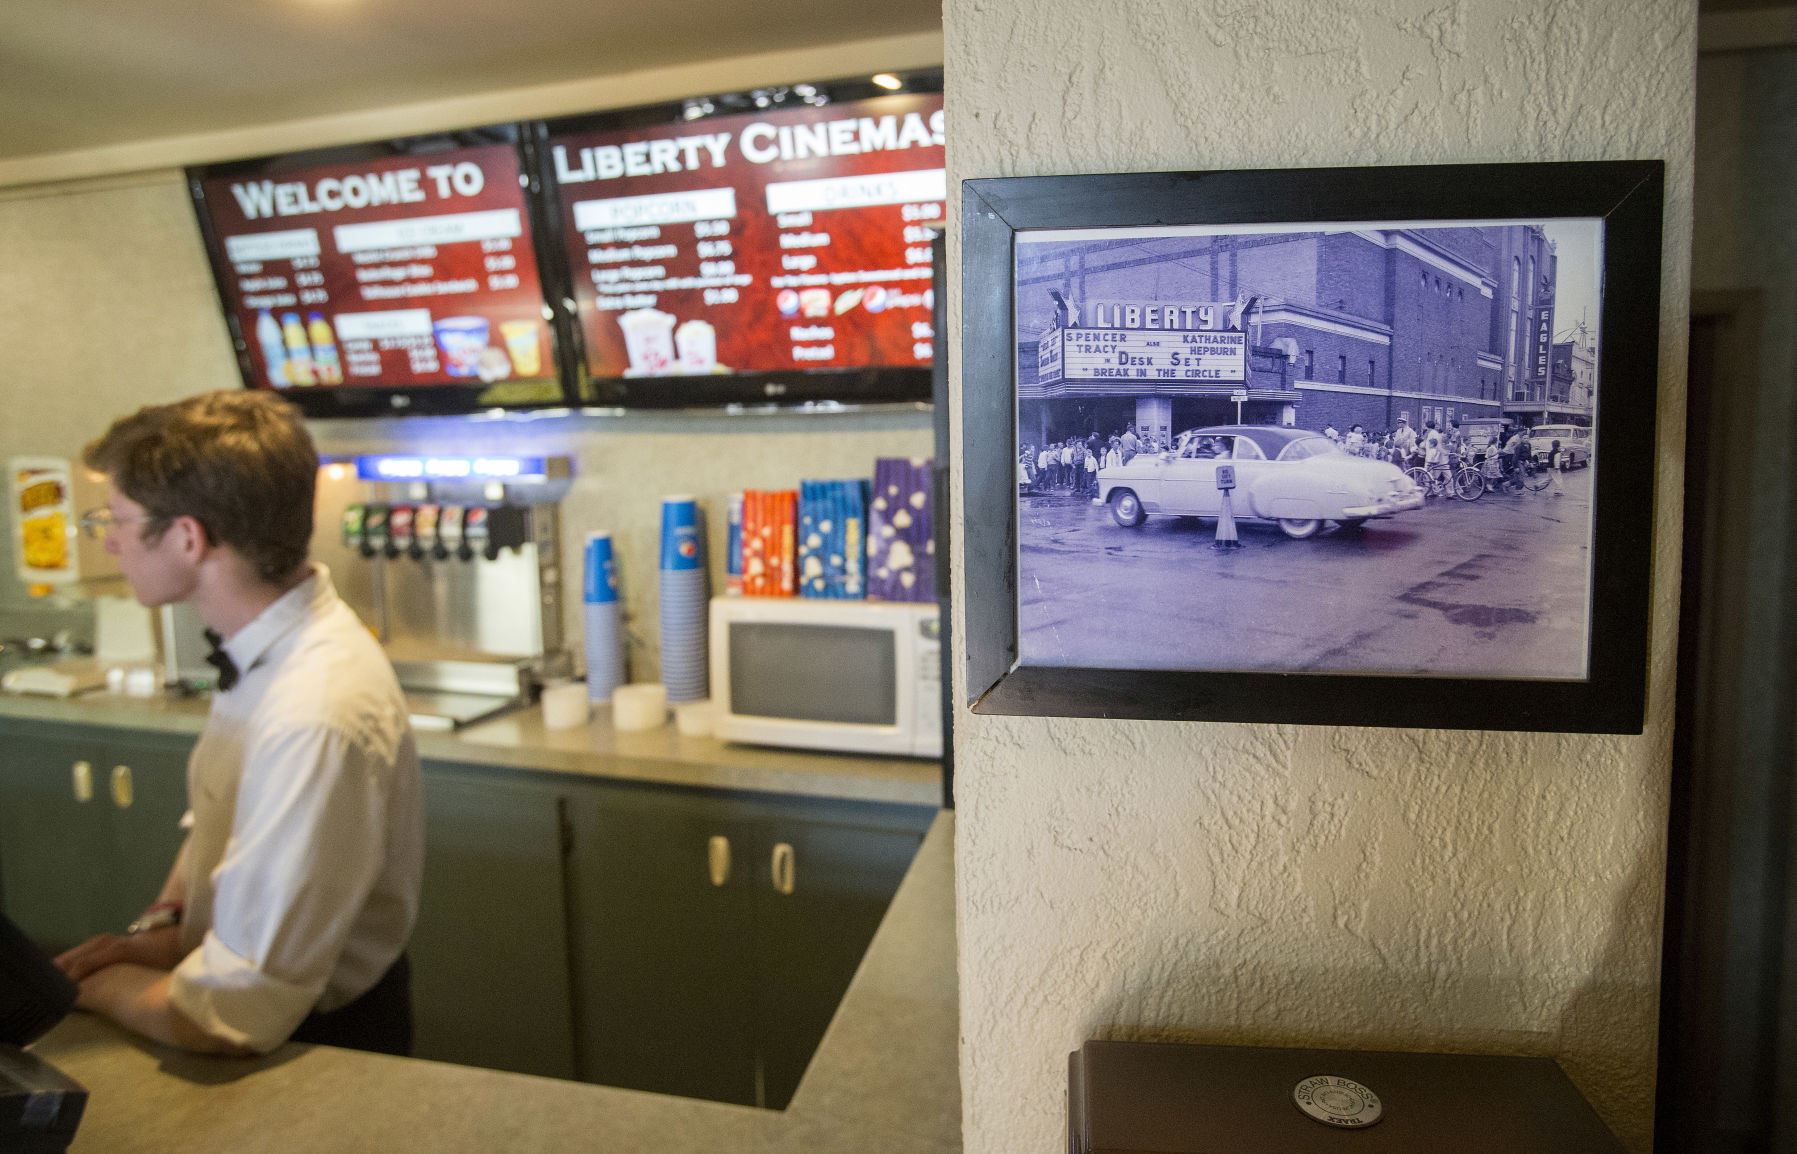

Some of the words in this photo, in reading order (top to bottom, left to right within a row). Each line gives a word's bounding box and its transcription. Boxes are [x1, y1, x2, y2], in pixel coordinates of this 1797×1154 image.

[551, 132, 732, 184] LIBERTY
[739, 109, 945, 164] CINEMAS
[232, 167, 425, 219] WELCOME
[427, 162, 484, 199] TO
[825, 182, 898, 202] DRINKS
[610, 199, 698, 220] POPCORN
[1096, 303, 1214, 330] LIBERTY
[1066, 332, 1127, 343] SPENCER
[1182, 334, 1244, 345] KATHARINE
[1537, 310, 1549, 376] EAGLES
[1076, 344, 1117, 354] TRACY
[1118, 350, 1154, 366] DESK
[1170, 352, 1202, 367] SET
[1189, 346, 1237, 356] HEPBURN
[1093, 367, 1130, 377] BREAK
[1136, 368, 1147, 378] IN
[1156, 368, 1176, 378] THE
[1184, 369, 1221, 379] CIRCLE
[1297, 1077, 1330, 1101] STRAW
